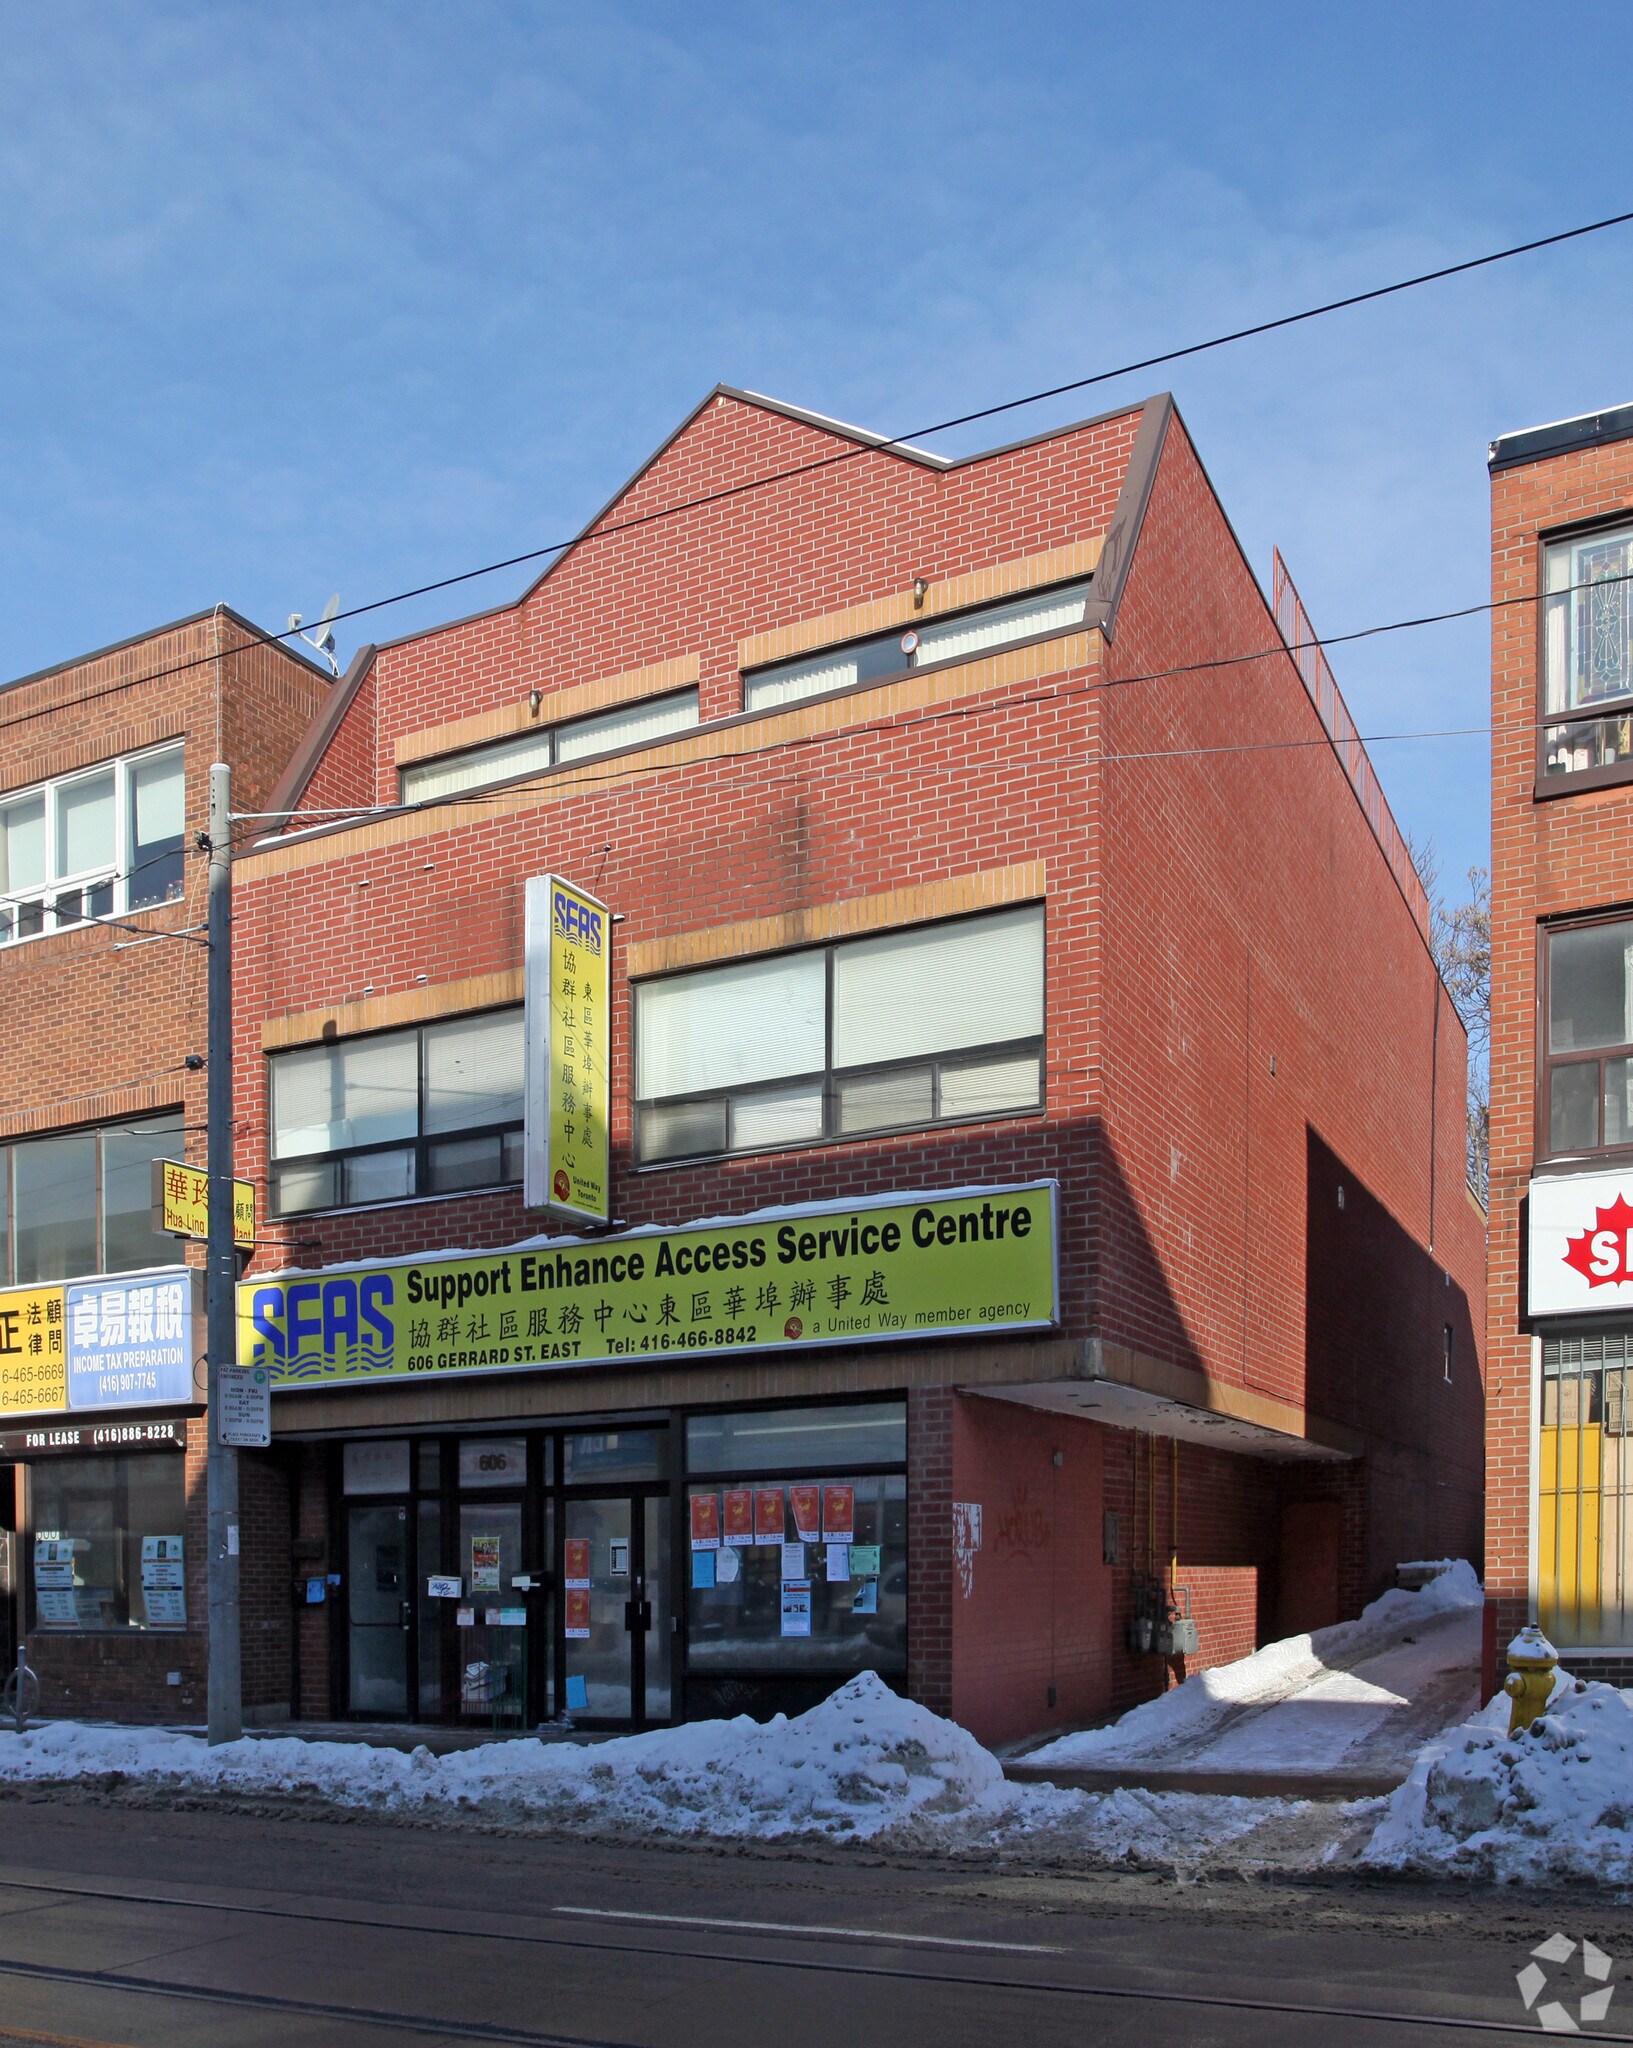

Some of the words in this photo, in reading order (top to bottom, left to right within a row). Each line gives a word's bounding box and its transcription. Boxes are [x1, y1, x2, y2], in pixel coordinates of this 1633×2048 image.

[572, 1175, 590, 1188] United
[591, 1181, 601, 1193] Way
[577, 1189, 597, 1202] Toronto
[167, 1209, 183, 1228] Hua
[187, 1213, 205, 1237] Ling
[407, 1261, 512, 1310] Support
[520, 1253, 645, 1292] Enhance
[654, 1238, 767, 1278] Access
[777, 1216, 902, 1265] Service
[911, 1202, 1032, 1249] Centre
[1588, 1228, 1633, 1277] S
[812, 1321, 820, 1334] a
[828, 1313, 871, 1333] United
[877, 1311, 907, 1330] Way
[914, 1306, 972, 1324] member
[978, 1302, 1031, 1321] agency
[73, 1354, 105, 1374] INCOME
[105, 1352, 122, 1370] TAX
[123, 1346, 184, 1369] PREPARATION
[407, 1354, 434, 1372] 606
[437, 1347, 510, 1369] GERRARD
[513, 1345, 536, 1363] ST.
[540, 1340, 581, 1360] EAST
[605, 1336, 636, 1355] Tel:
[640, 1325, 757, 1352] 416-466-8842
[99, 1374, 119, 1397] (416)
[120, 1371, 156, 1391] 907-7745
[26, 1433, 46, 1447] FOR
[49, 1430, 80, 1446] LEASE
[93, 1424, 174, 1444] (416)886-8228
